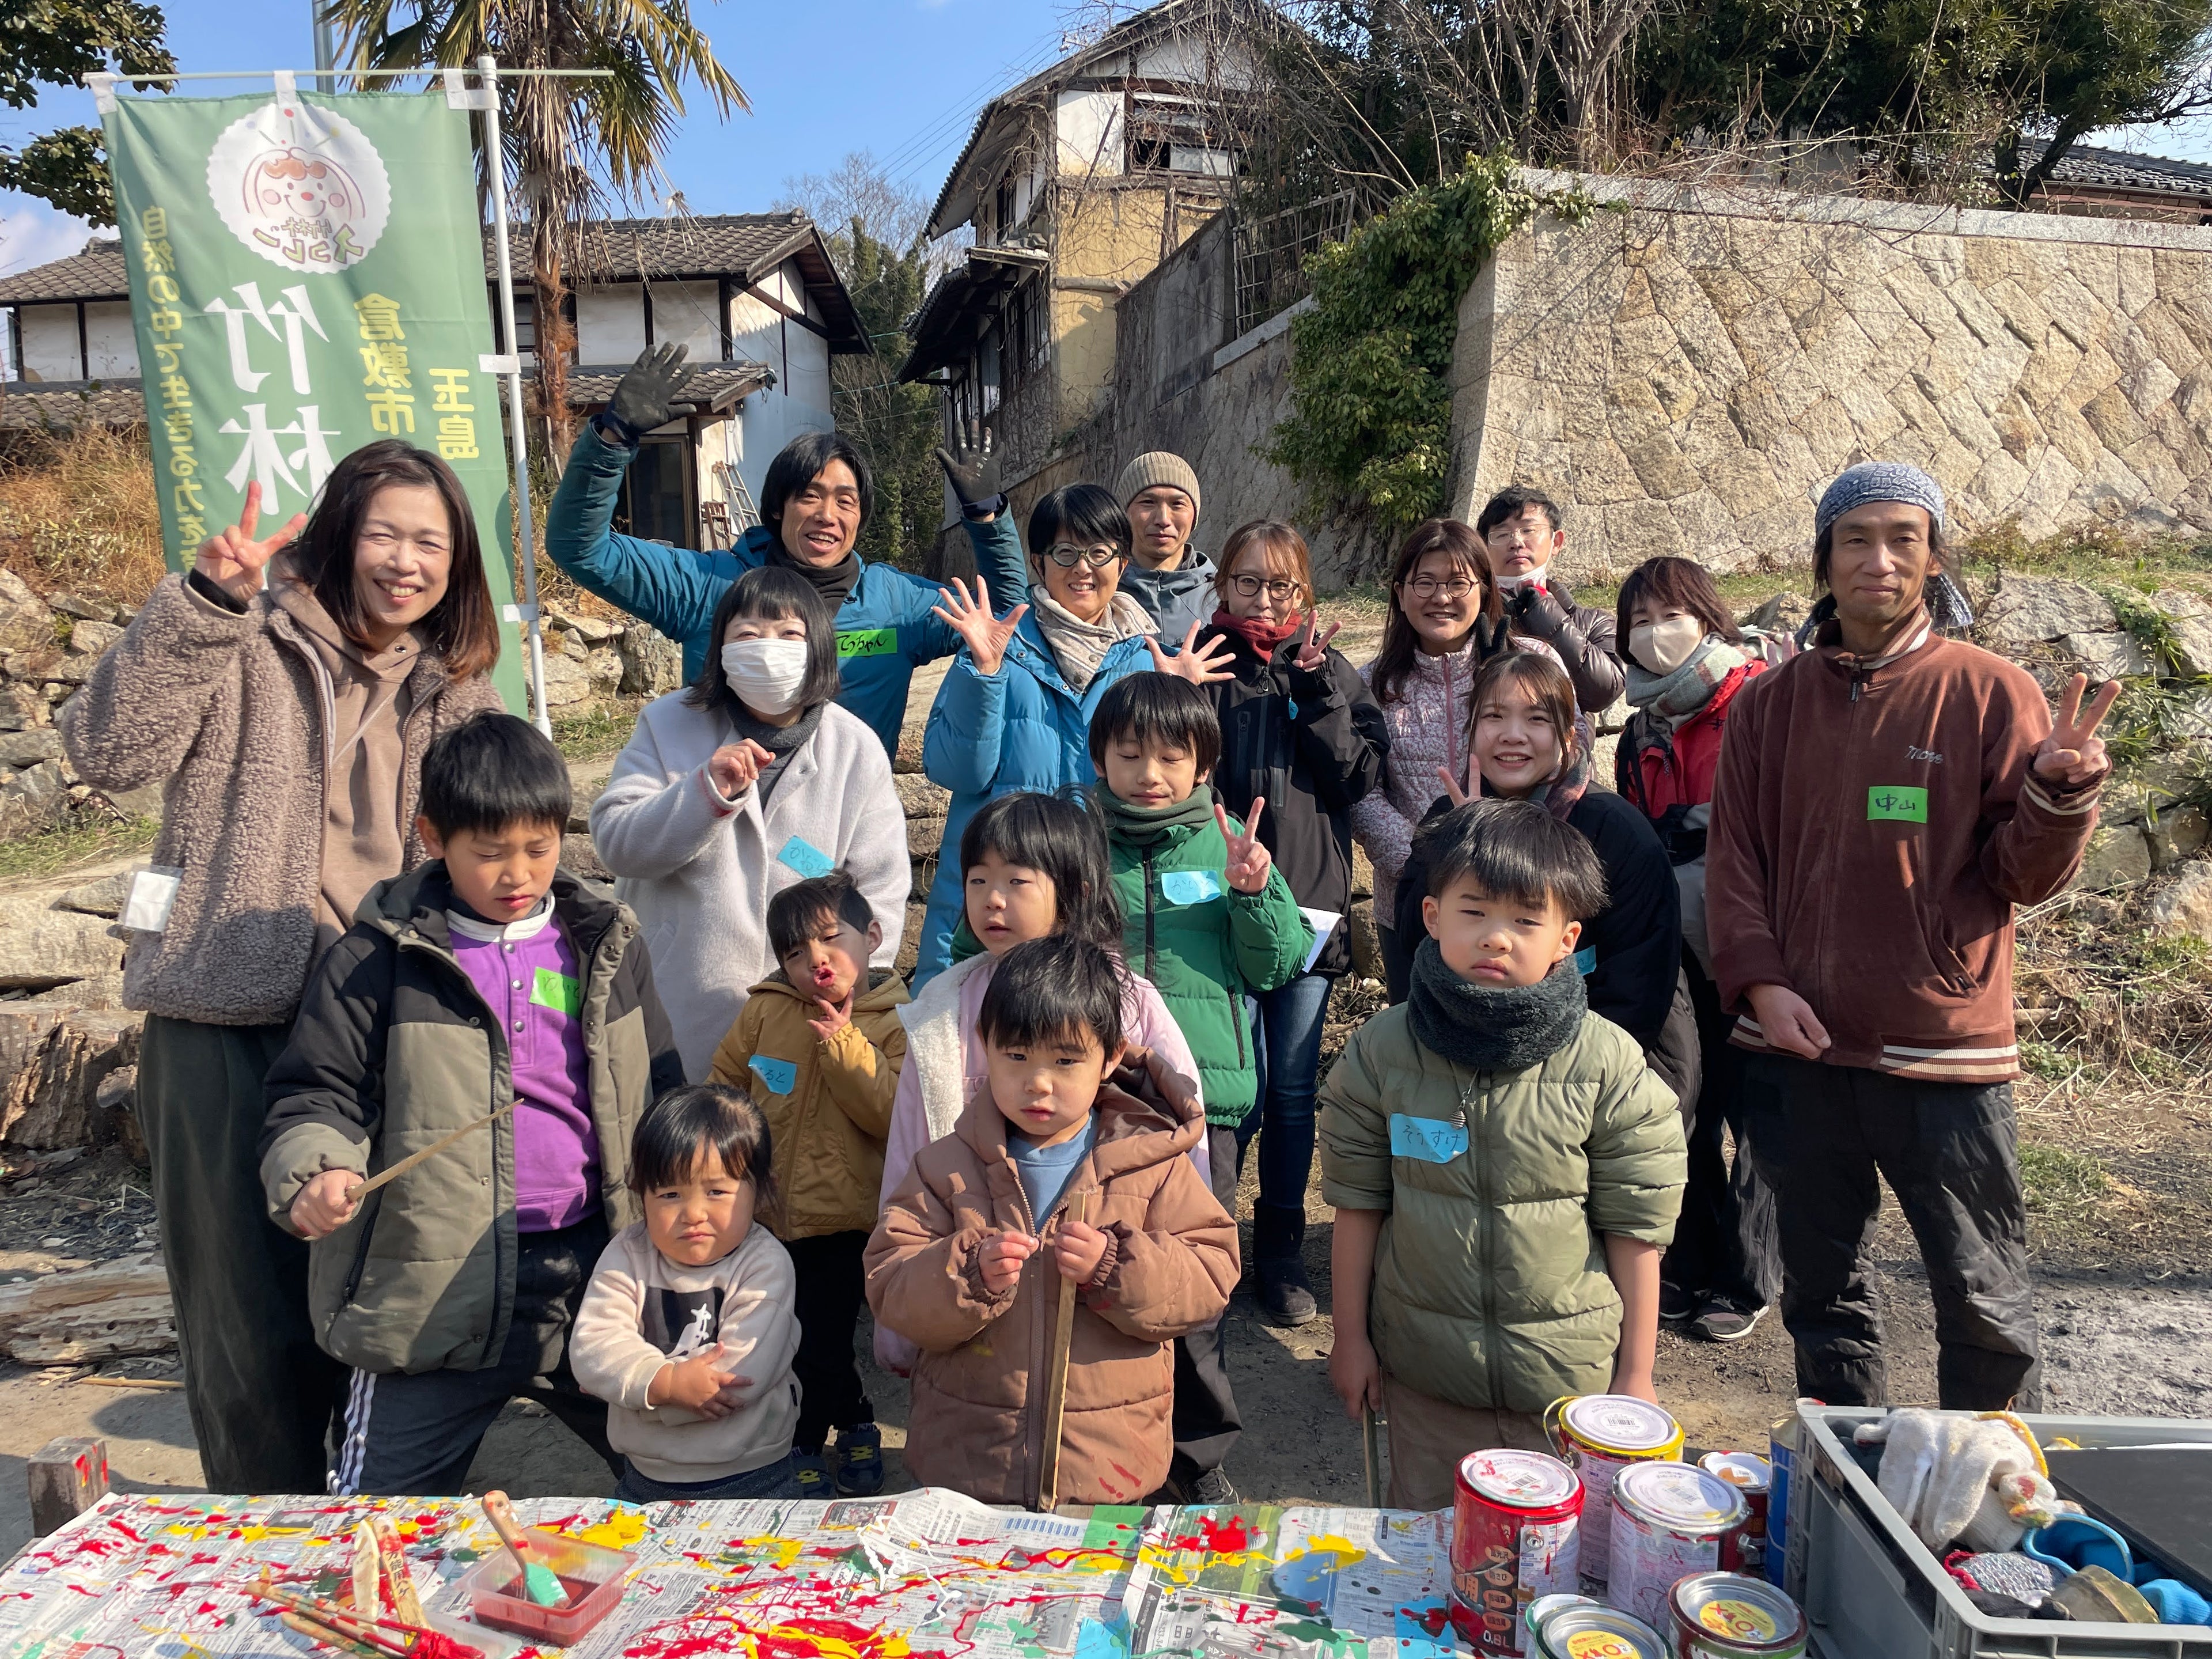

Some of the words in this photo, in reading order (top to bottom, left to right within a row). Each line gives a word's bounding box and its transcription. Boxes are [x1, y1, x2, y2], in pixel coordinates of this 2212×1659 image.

[1875, 794, 1916, 812] 中山
[1403, 1125, 1461, 1152] そうすけ
[1483, 1630, 1510, 1648] 0.8L
